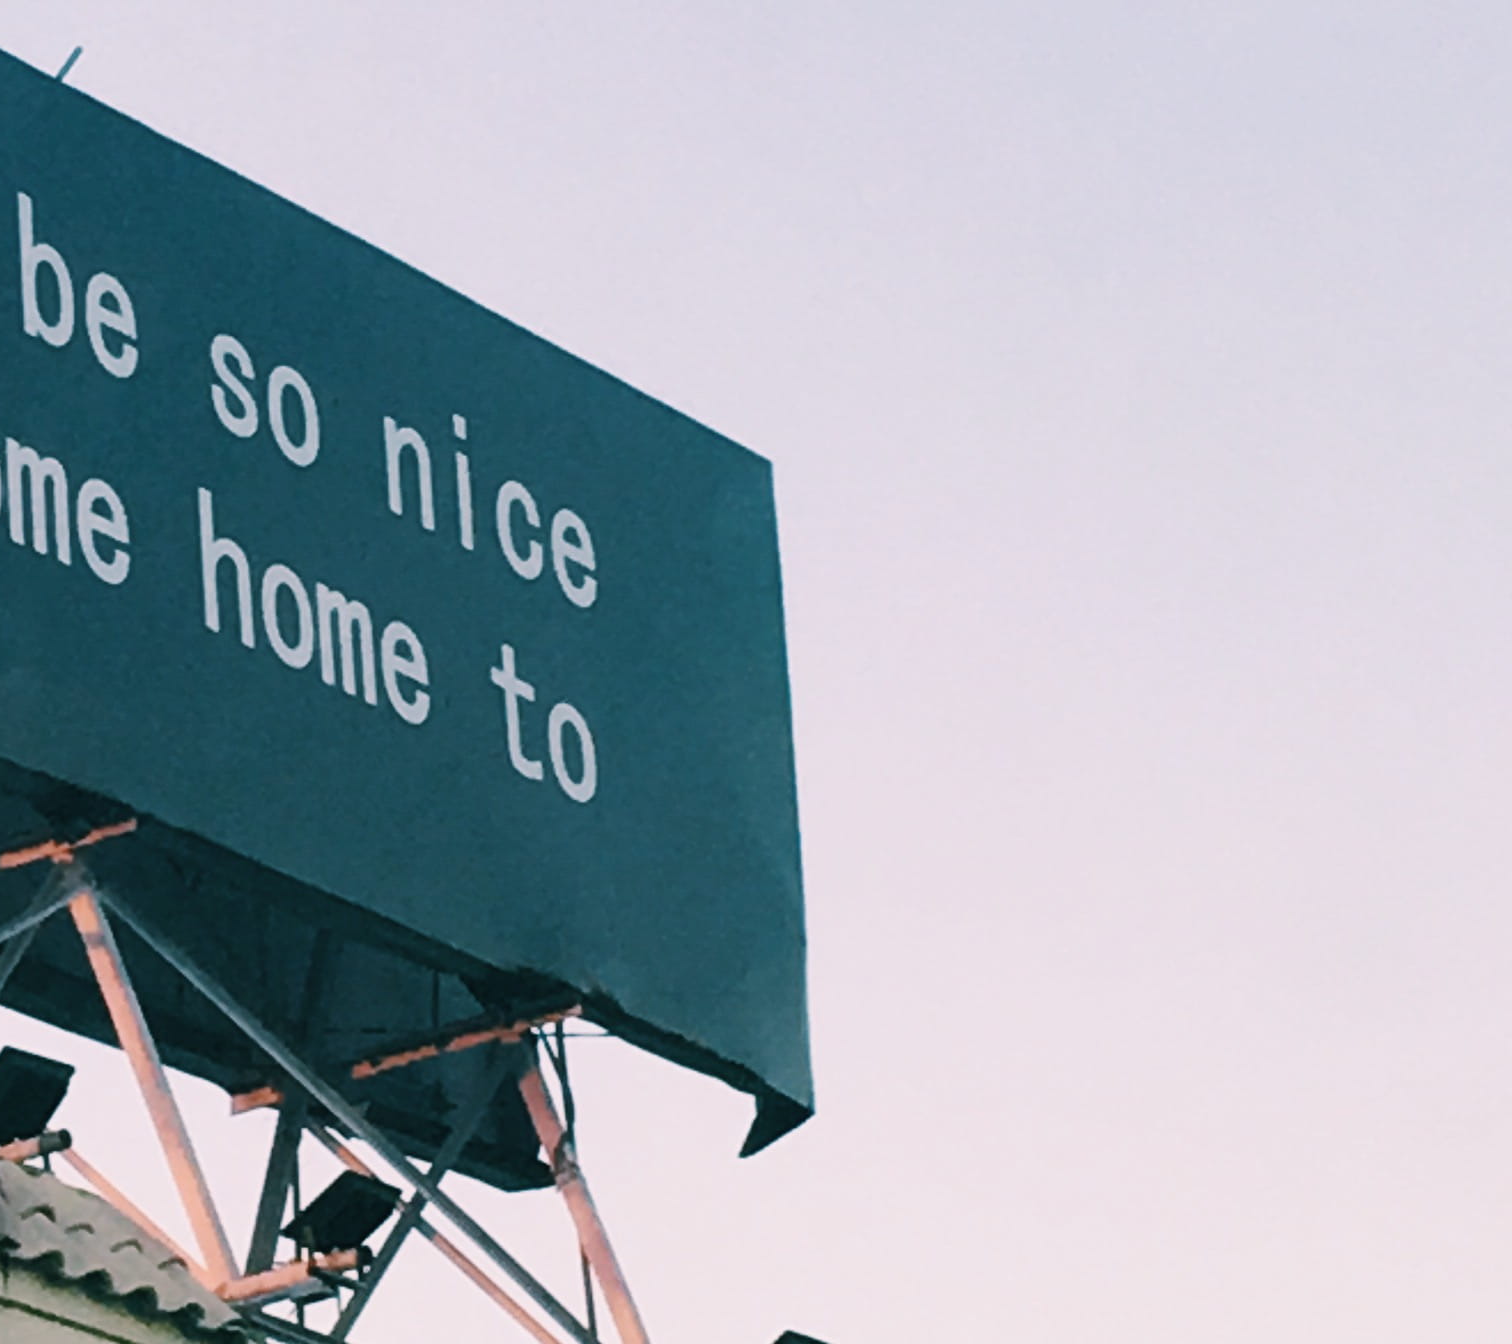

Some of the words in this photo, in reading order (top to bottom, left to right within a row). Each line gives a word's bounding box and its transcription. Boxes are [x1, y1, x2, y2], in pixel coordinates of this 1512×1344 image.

[18, 192, 138, 378] be
[211, 335, 319, 466] so
[383, 414, 597, 608] nice
[198, 487, 430, 724] home
[490, 644, 596, 803] to
